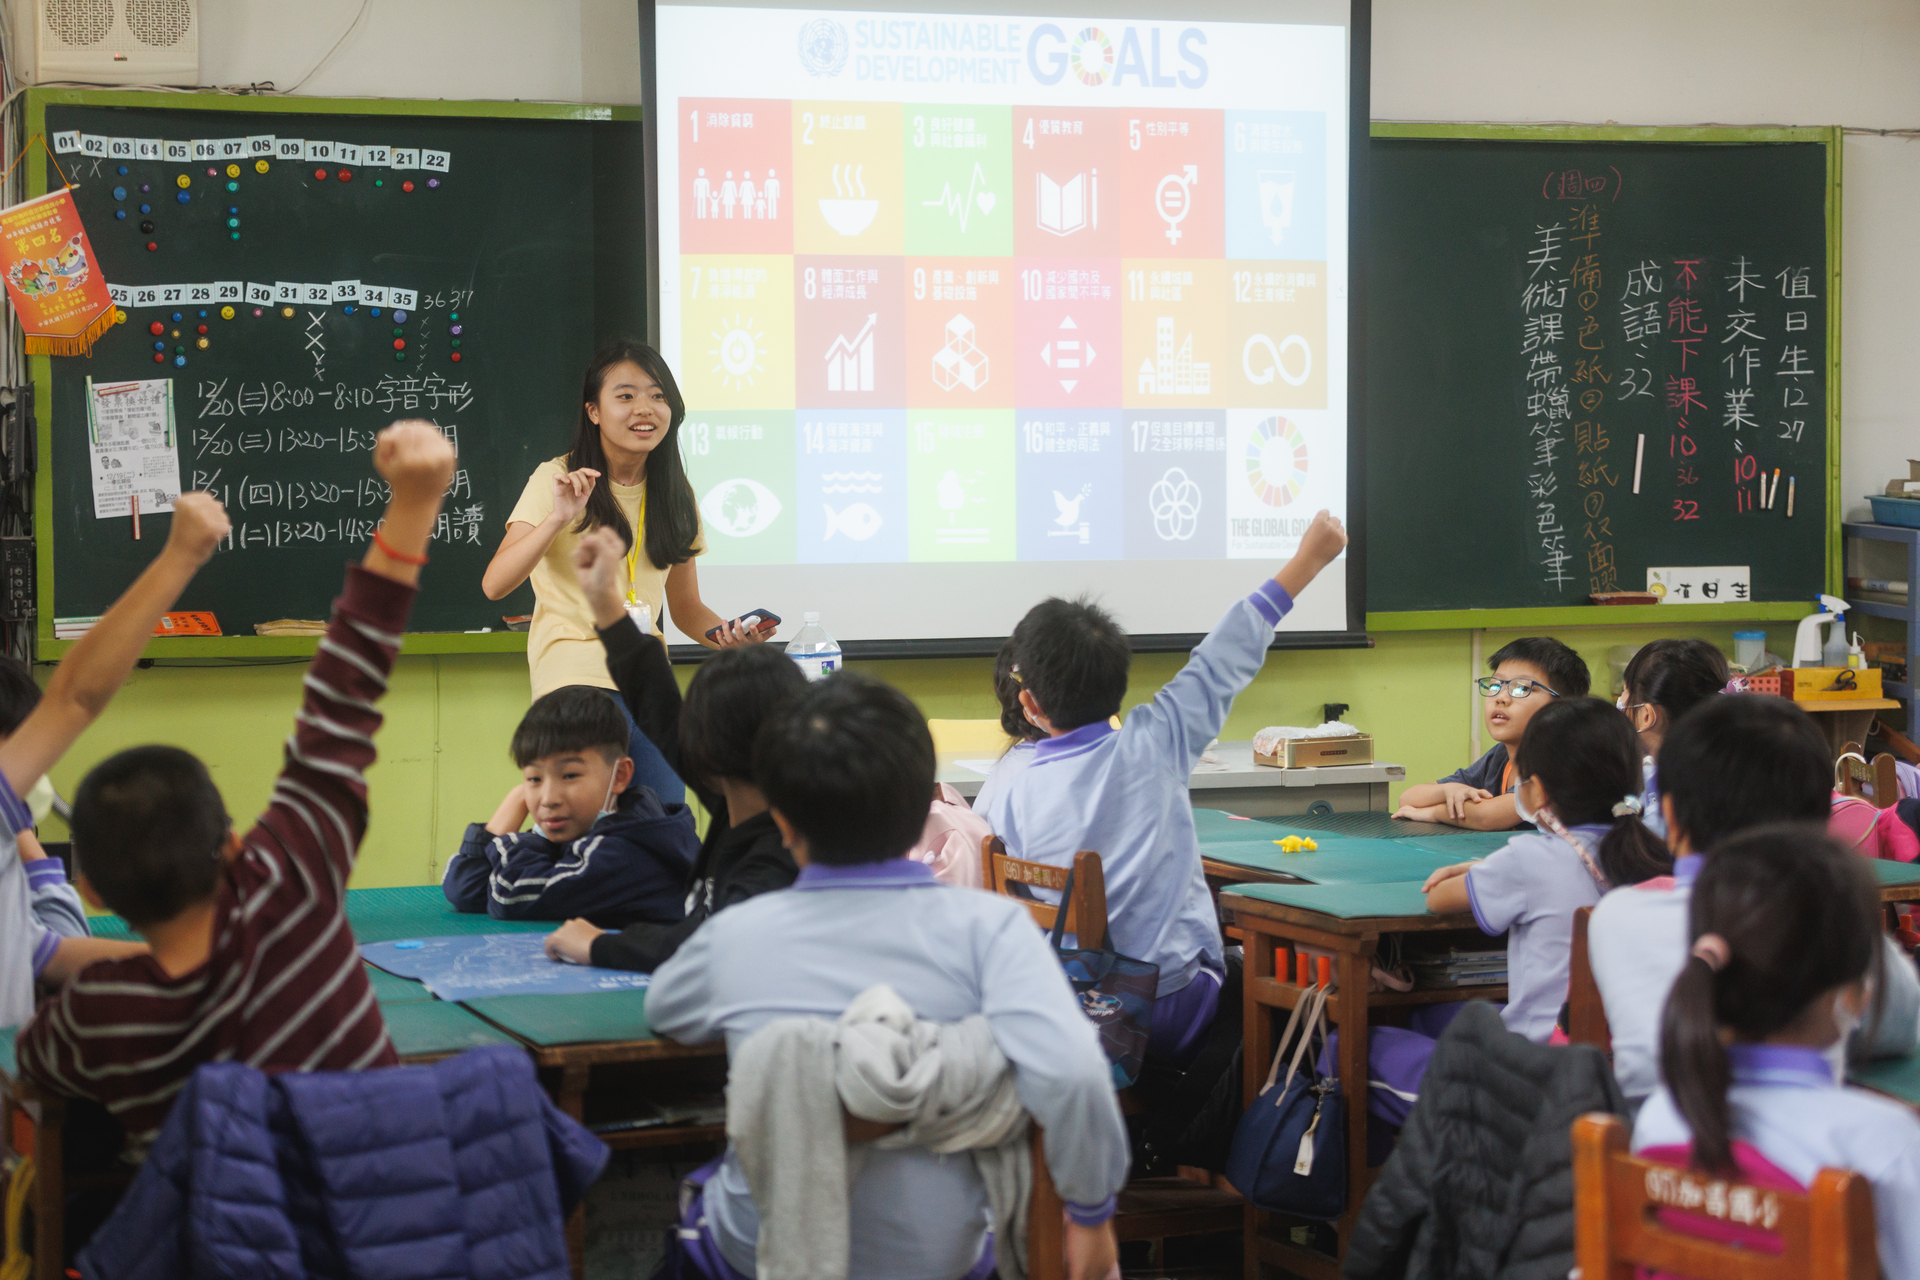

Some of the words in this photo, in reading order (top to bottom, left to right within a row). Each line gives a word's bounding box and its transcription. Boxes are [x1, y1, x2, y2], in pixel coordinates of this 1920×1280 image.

[855, 19, 1021, 53] SUSTAINABLE
[1027, 23, 1209, 89] GOALS
[855, 54, 1021, 85] DEVELOPMENT
[690, 109, 699, 143] 1
[706, 113, 754, 129] 消除貧窮
[802, 111, 814, 145] 2
[913, 115, 925, 147] 3
[930, 117, 975, 133] 良好健康
[930, 133, 987, 149] 與社會福利
[1022, 117, 1035, 149] 4
[1039, 119, 1083, 135] 優質教育
[1129, 119, 1141, 151] 5
[1145, 121, 1189, 137] 性別平等
[1234, 121, 1246, 153] 6
[59, 136, 75, 148] 01
[85, 140, 103, 152] 02
[113, 142, 130, 154] 03
[140, 144, 158, 156] 04
[168, 145, 186, 157] 05
[196, 144, 215, 156] 06
[224, 143, 242, 155] 07
[252, 140, 271, 152] 08
[281, 144, 299, 155] 09
[311, 146, 329, 157] 10
[340, 148, 356, 160] 11
[368, 150, 386, 162] 12
[396, 153, 413, 165] 21
[426, 155, 445, 167] 22
[1543, 165, 1622, 202] (週四)
[14, 228, 62, 255] 第四名
[110, 289, 128, 301] 25
[138, 290, 156, 302] 26
[164, 289, 181, 301] 27
[191, 288, 210, 300] 28
[220, 286, 238, 298] 29
[251, 288, 270, 301] 30
[280, 287, 297, 299] 31
[308, 288, 328, 300] 32
[337, 285, 357, 297] 33
[365, 289, 383, 302] 34
[393, 293, 412, 306] 35
[689, 266, 701, 299] 7
[803, 267, 817, 300] 8
[821, 268, 878, 284] 體面工作與
[821, 284, 867, 300] 經濟成長
[913, 267, 926, 300] 9
[932, 269, 999, 285] 產業、創新與
[932, 285, 977, 301] 基礎設施
[1021, 269, 1042, 300] 10
[1045, 270, 1101, 285] 減少國內及
[1045, 285, 1112, 300] 國家間不平等
[1128, 269, 1144, 301] 11
[1150, 286, 1182, 301] 與社區
[1232, 271, 1251, 302] 12
[1254, 288, 1296, 303] 生產模式
[424, 291, 446, 310] 36
[450, 289, 474, 311] 37
[1618, 367, 1655, 400] 32
[1783, 387, 1809, 408] 12
[101, 394, 161, 409] 發票換好禮
[688, 422, 710, 456] 13
[715, 425, 763, 441] 氣候行動
[803, 422, 824, 454] 14
[826, 422, 883, 437] 保育海洋與
[914, 421, 935, 453] 15
[1023, 421, 1043, 453] 16
[1044, 422, 1110, 436] 和平、正義與
[1044, 437, 1099, 452] 健全的司法
[1130, 420, 1149, 453] 17
[1151, 422, 1215, 436] 促進目標實現
[1151, 437, 1226, 451] 之全球夥伴關係
[1670, 434, 1697, 458] 10
[1777, 420, 1805, 442] 27
[1735, 455, 1757, 484] 10
[1672, 499, 1700, 520] 32
[1231, 518, 1250, 537] THE
[1251, 518, 1290, 537] GLOBAL
[1673, 582, 1748, 599] 值日生
